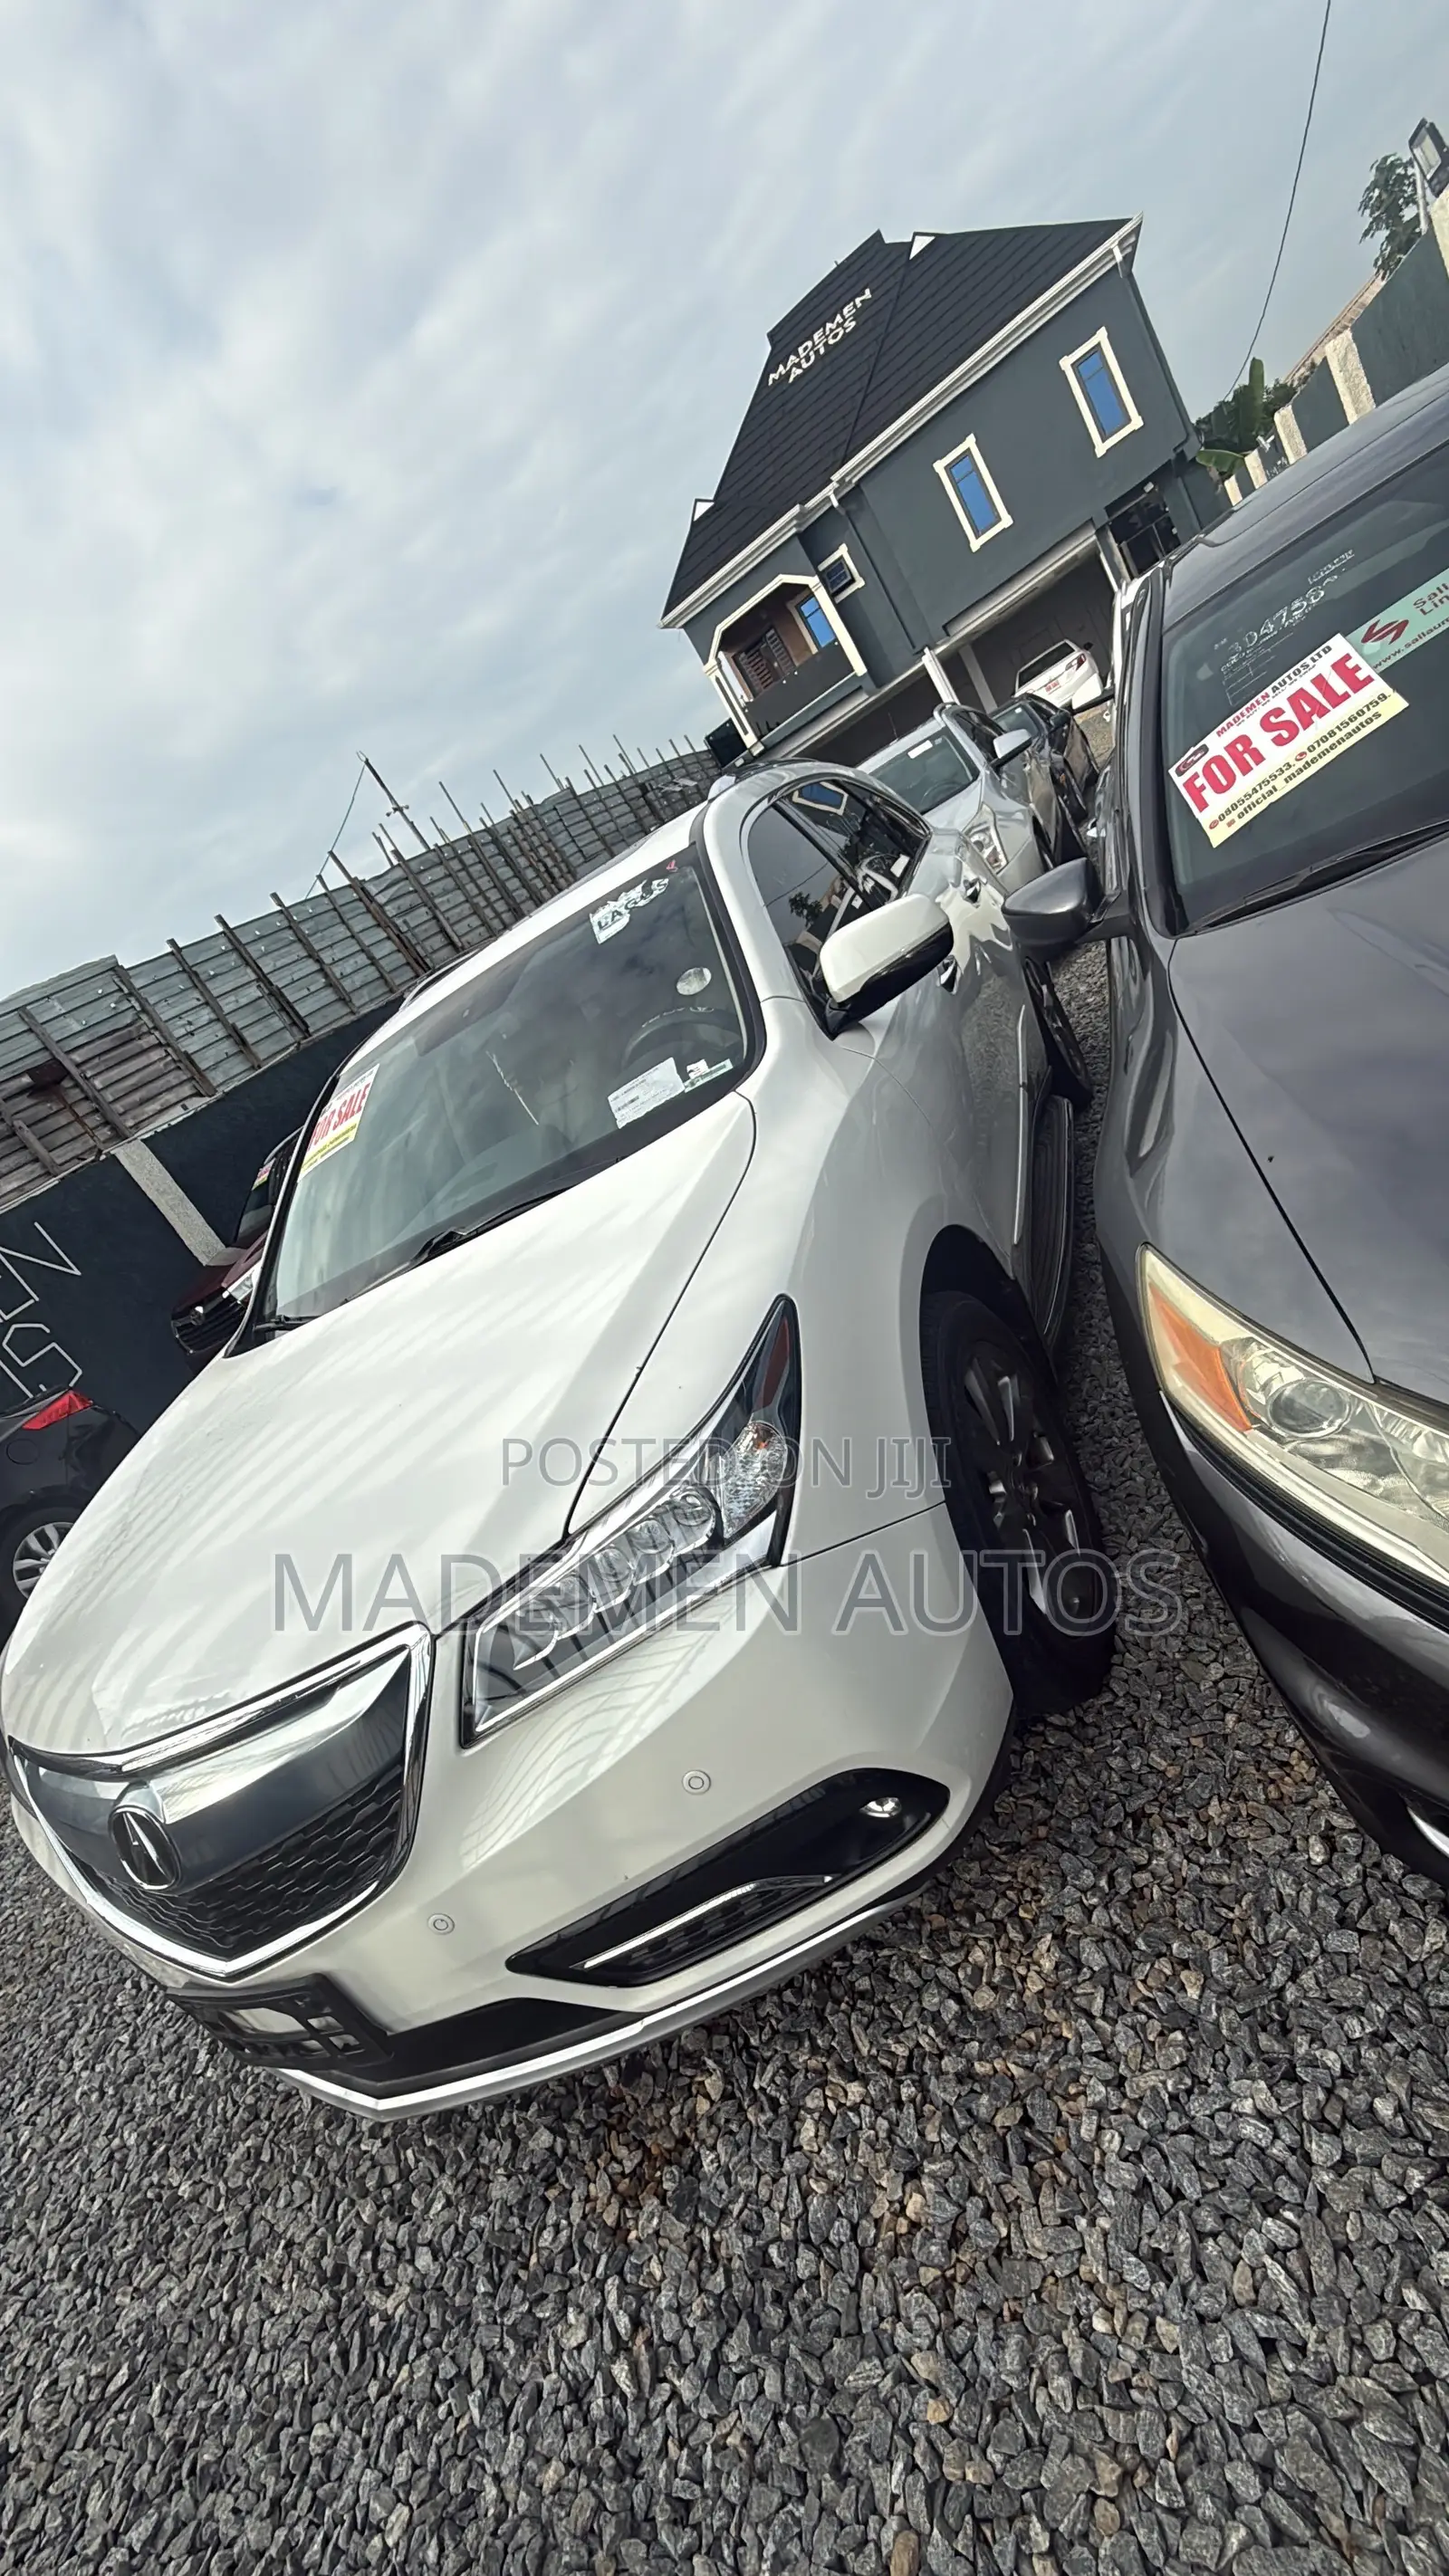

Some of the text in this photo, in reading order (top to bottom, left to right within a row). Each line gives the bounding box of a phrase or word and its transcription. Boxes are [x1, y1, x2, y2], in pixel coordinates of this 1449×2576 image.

[768, 287, 872, 386] MADEMEN
[788, 316, 857, 384] AUTOS
[1182, 652, 1375, 814] FOR SALE
[1215, 644, 1333, 738] MADEMEN AUTOS LTD
